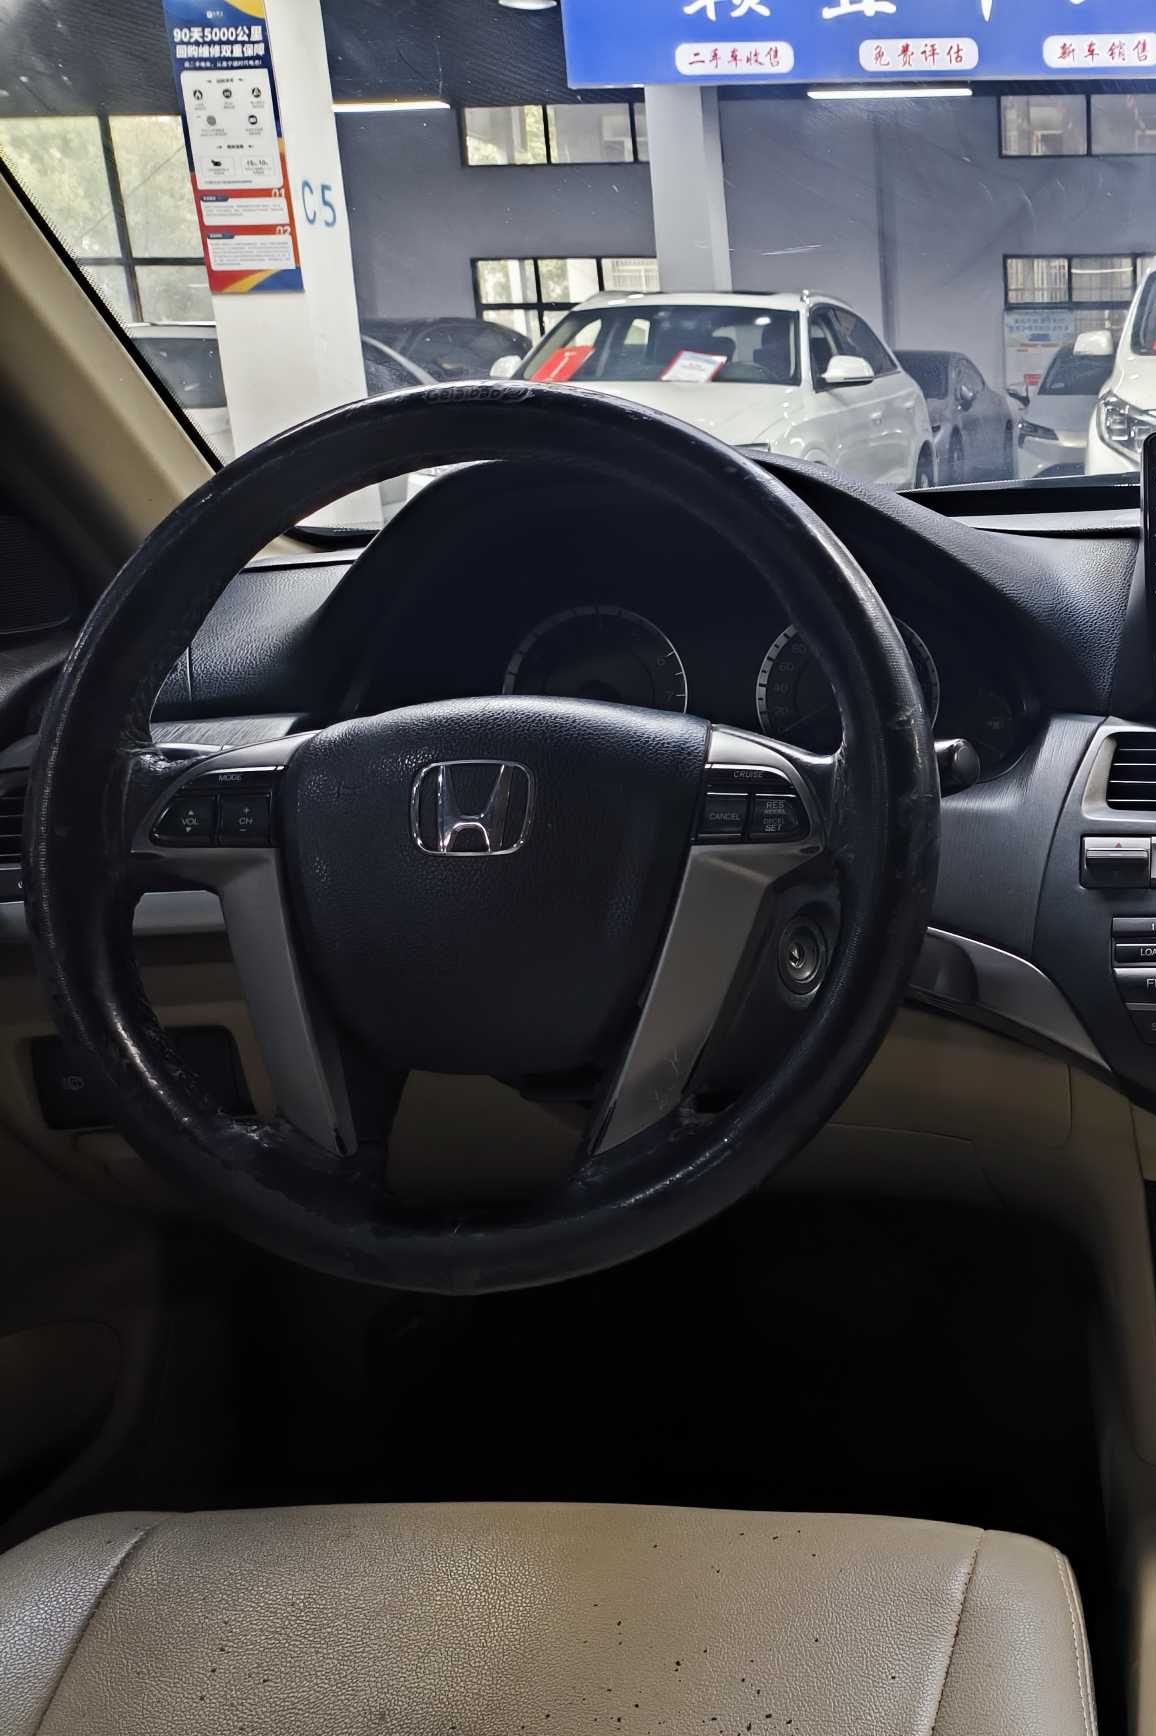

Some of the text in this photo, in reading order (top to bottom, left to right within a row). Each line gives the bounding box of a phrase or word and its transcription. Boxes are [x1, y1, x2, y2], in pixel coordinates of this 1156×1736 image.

[173, 25, 263, 42] 90天5000公里
[688, 46, 782, 69] 二手车收售
[872, 43, 965, 68] 免费评估
[1058, 39, 1151, 64] 新车销售
[301, 179, 337, 227] C5
[733, 770, 763, 778] CRUISE
[182, 817, 198, 825] VOL
[1151, 923, 1156, 932] 1
